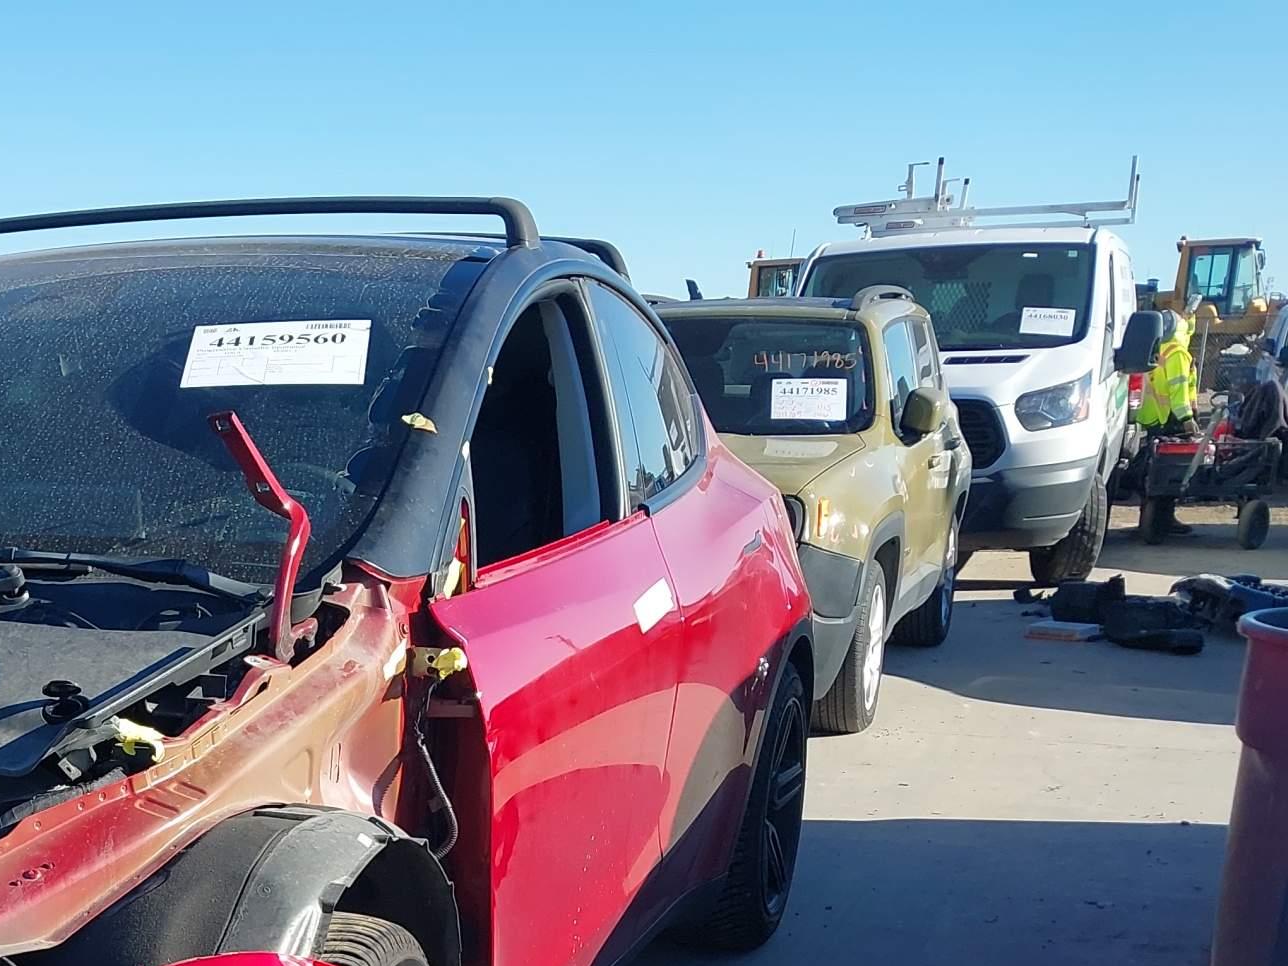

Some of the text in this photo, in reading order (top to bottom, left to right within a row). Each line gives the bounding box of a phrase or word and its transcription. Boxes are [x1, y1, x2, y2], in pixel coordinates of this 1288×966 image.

[209, 333, 346, 347] 44159560
[754, 351, 857, 372] 44171985
[779, 387, 838, 395] 44171985
